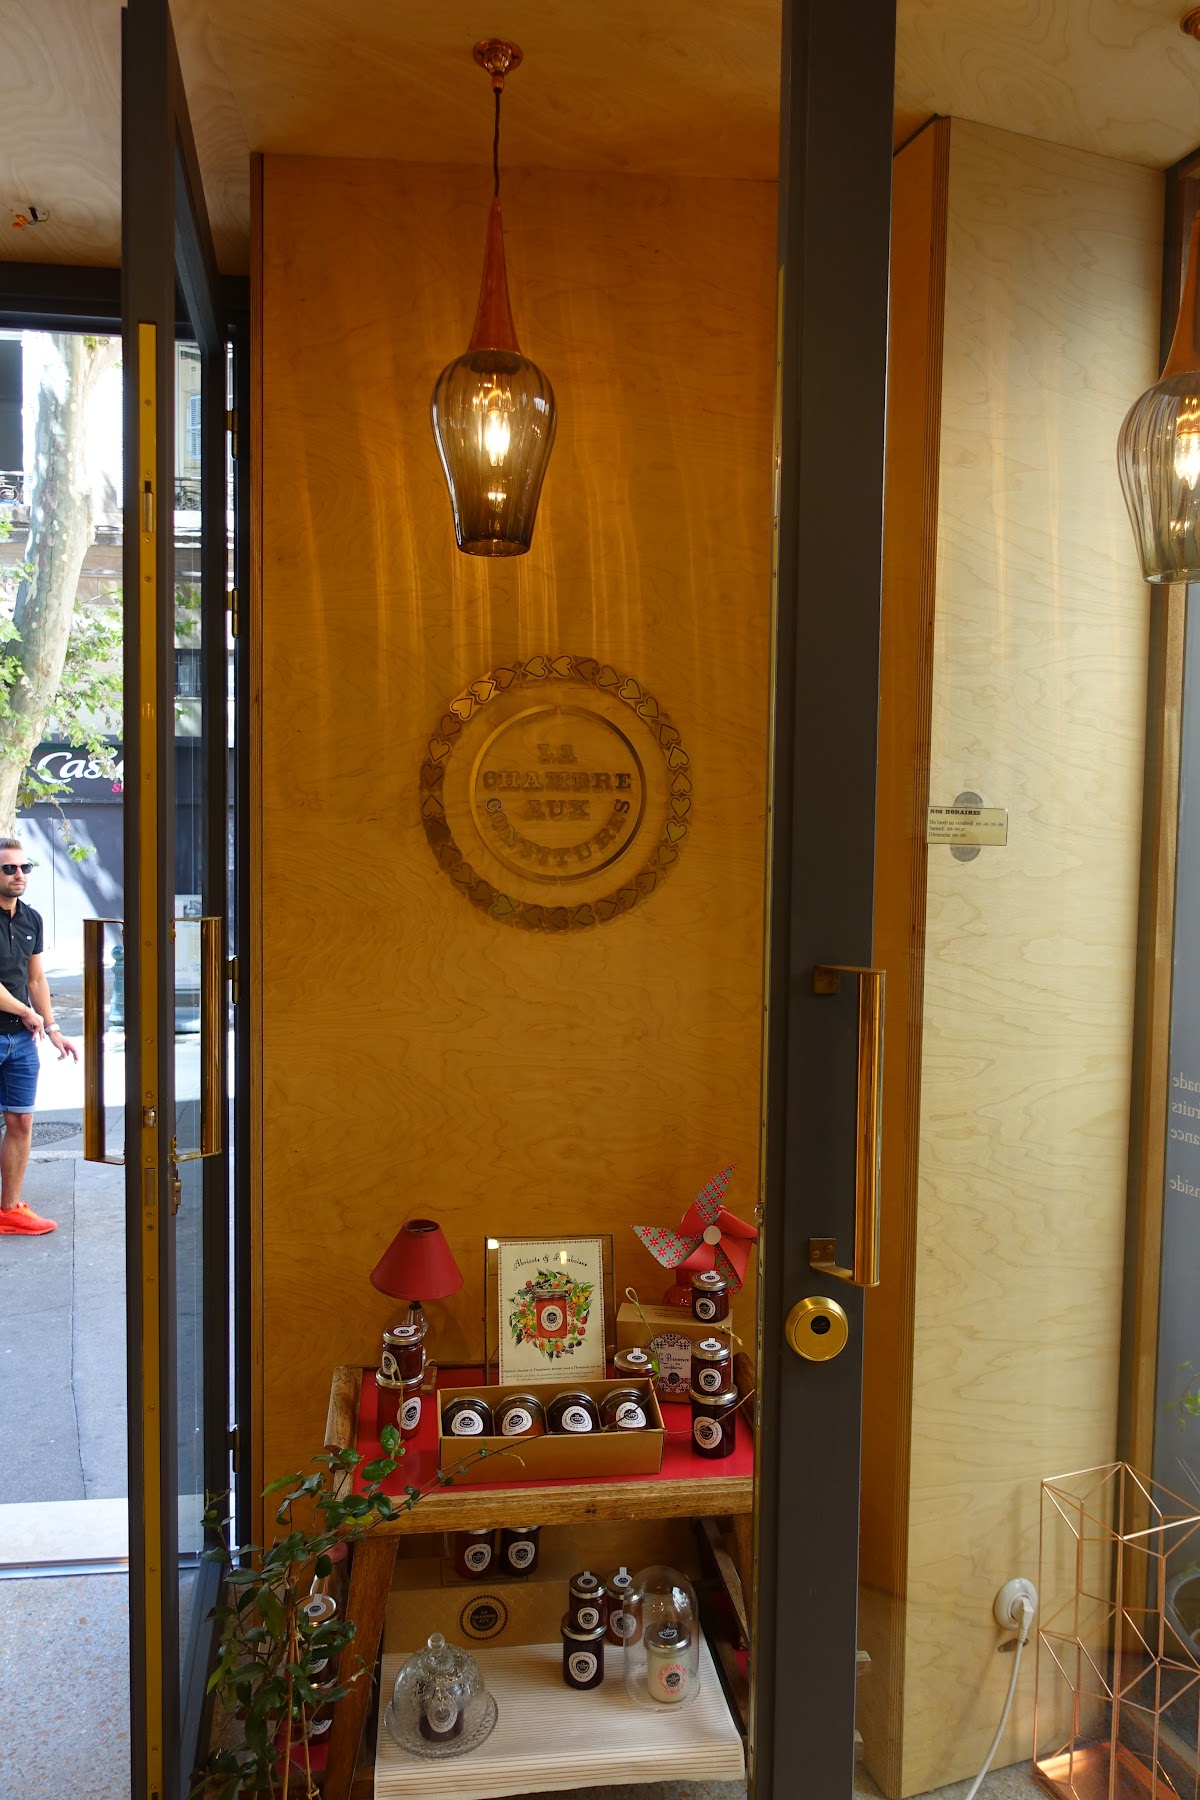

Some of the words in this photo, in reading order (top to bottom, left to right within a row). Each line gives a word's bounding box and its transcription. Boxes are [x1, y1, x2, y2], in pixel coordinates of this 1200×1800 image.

[538, 743, 578, 765] LA
[483, 770, 632, 793] CHAMBRE
[523, 799, 590, 821] AUX
